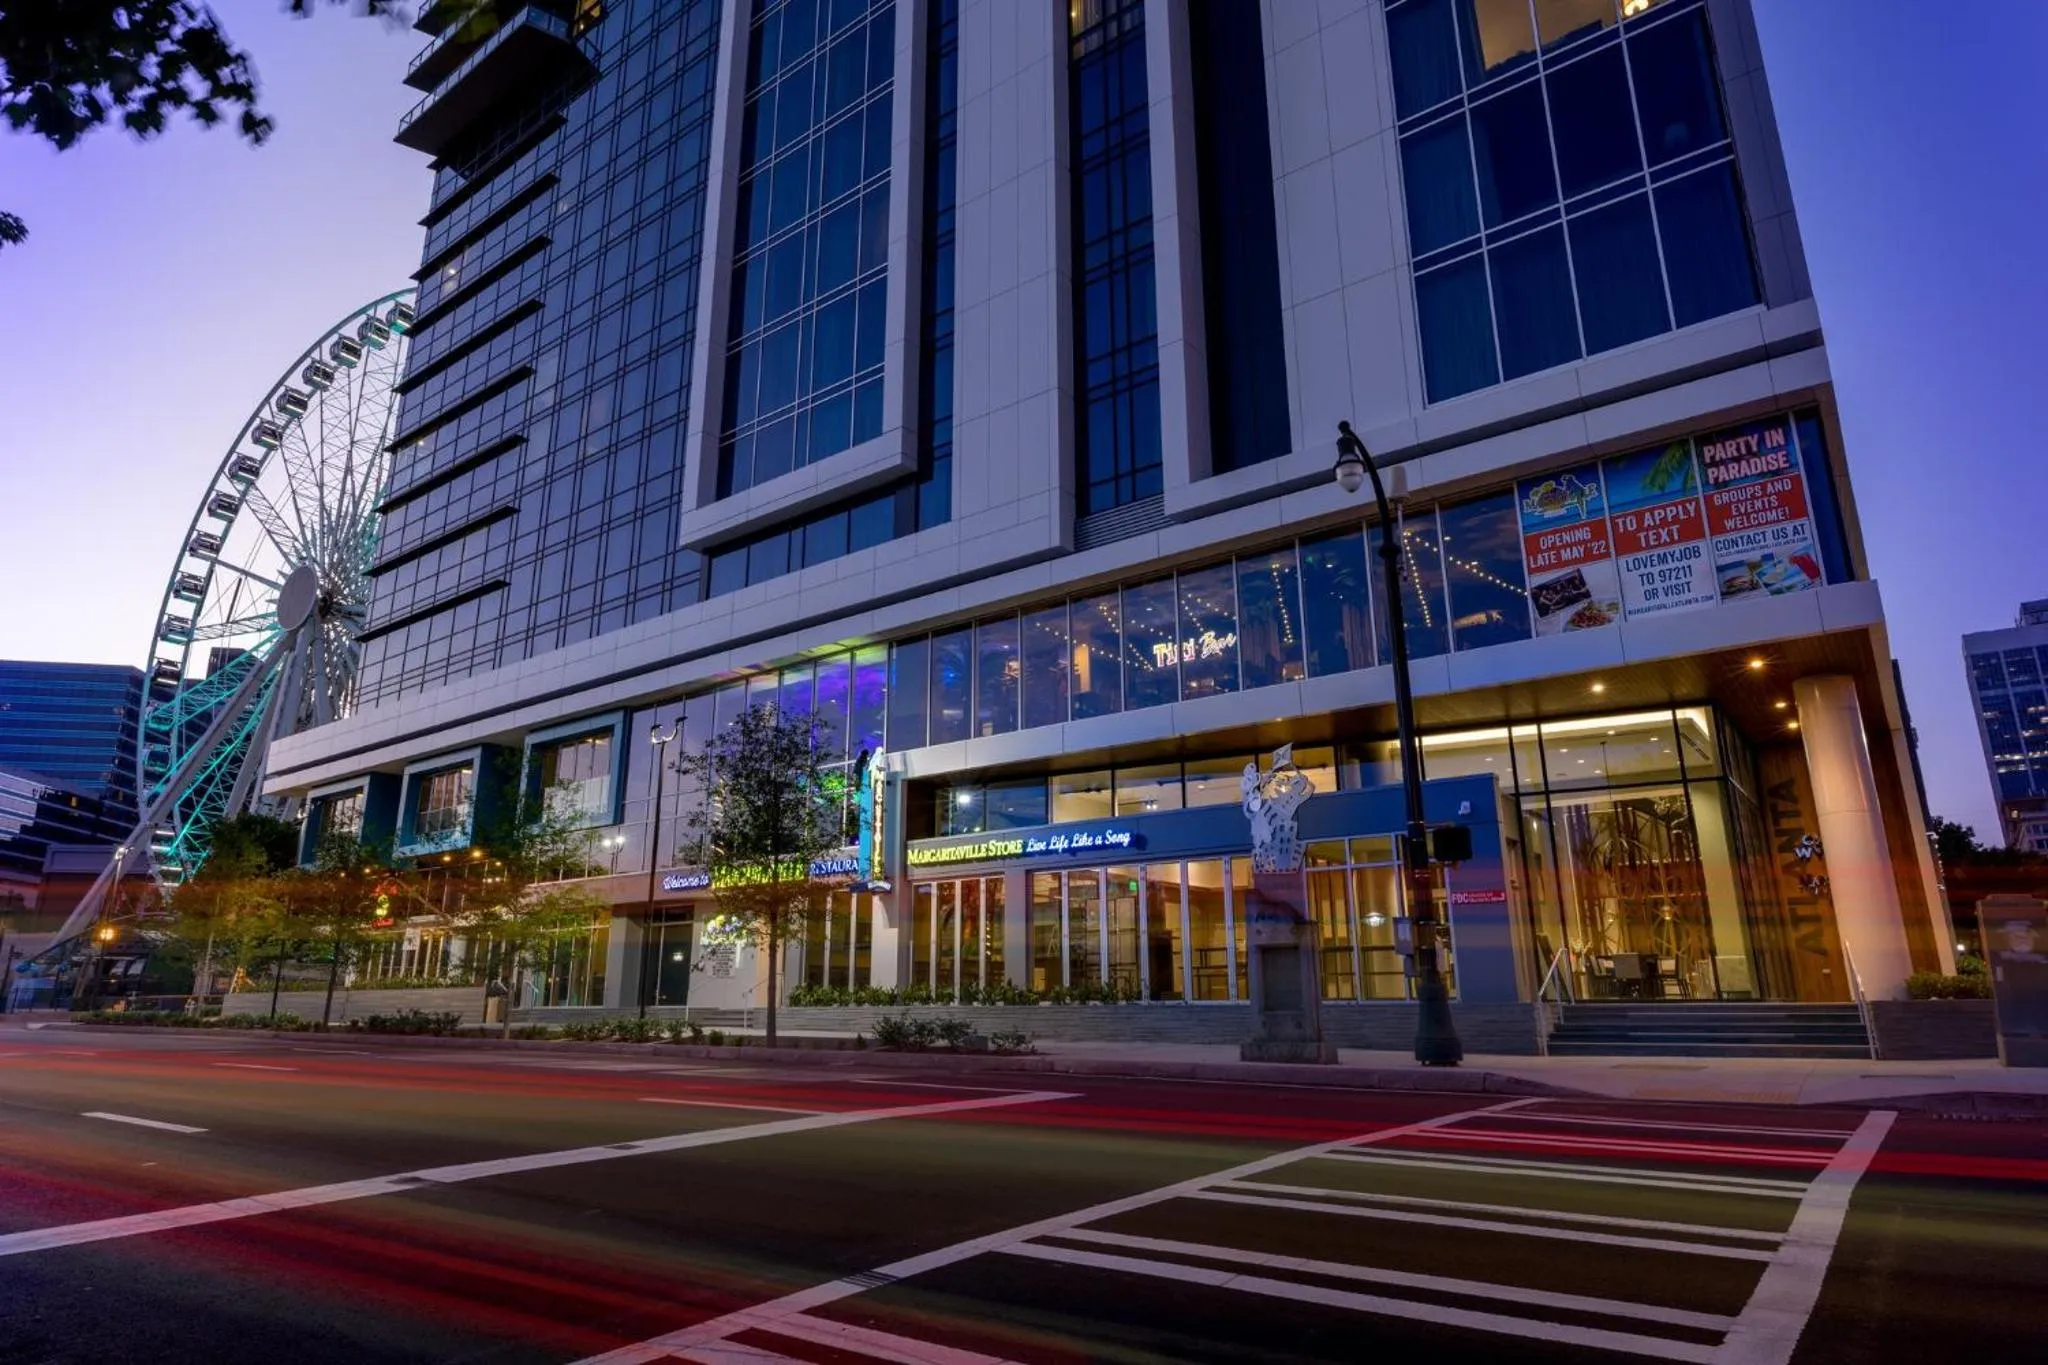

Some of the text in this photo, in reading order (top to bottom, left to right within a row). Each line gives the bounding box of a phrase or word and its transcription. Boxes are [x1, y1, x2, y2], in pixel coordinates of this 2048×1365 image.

[1703, 428, 1786, 464] PARTY IN
[1706, 450, 1790, 485] PARADISE
[1713, 479, 1793, 506] GROUPS AND
[1613, 501, 1698, 534] TO APPLY
[1723, 507, 1790, 530] WELCOME!
[1731, 496, 1779, 517] EVENTS
[1540, 526, 1591, 550] OPENING
[1637, 524, 1681, 549] TEXT
[1715, 531, 1767, 553] CONTACT
[1771, 527, 1788, 541] US
[1792, 523, 1805, 537] AT
[1530, 549, 1557, 568] LATE
[1560, 545, 1584, 562] MAY
[1626, 544, 1702, 573] LOVEMYJOB
[1638, 564, 1693, 588] TO 97211
[1644, 580, 1693, 601] OR VISIT
[1198, 630, 1236, 659] Bar
[907, 829, 1131, 865] MARGARITAVILLE STORE Live Life Like a Song
